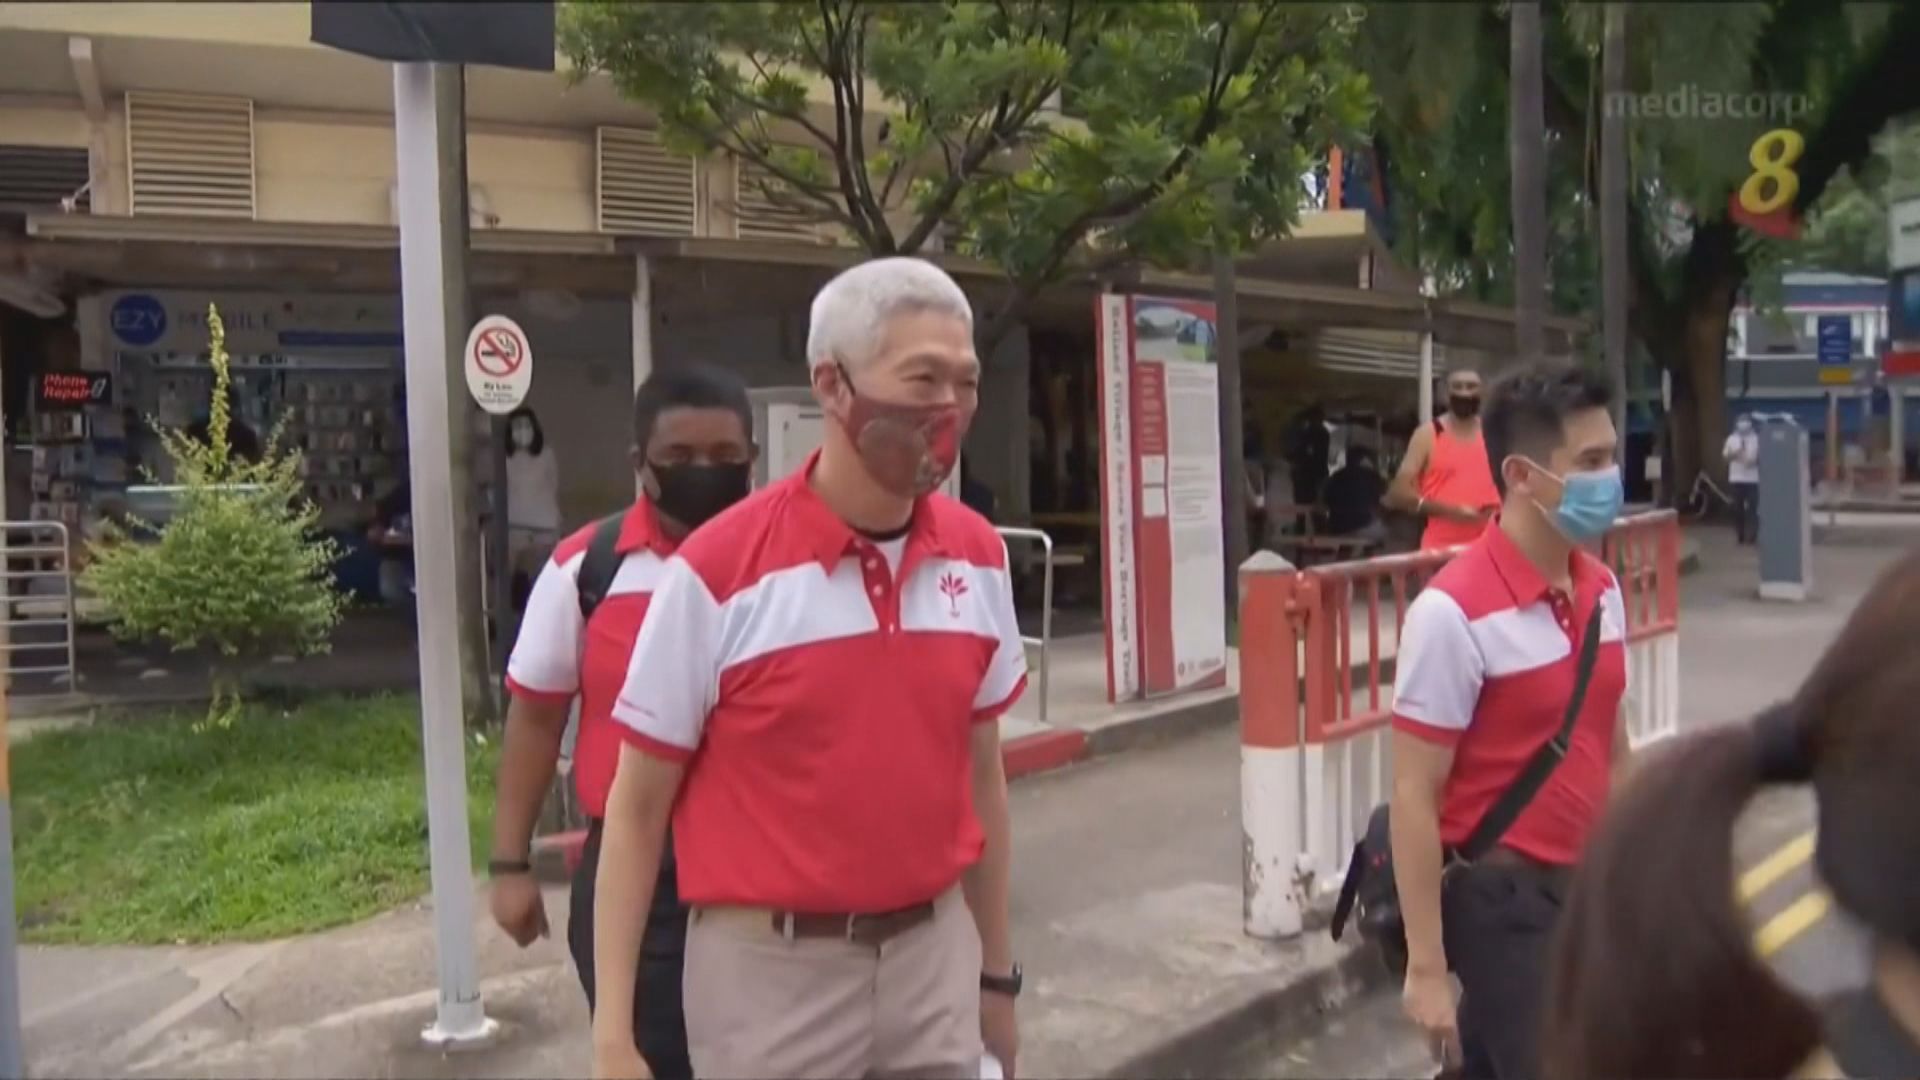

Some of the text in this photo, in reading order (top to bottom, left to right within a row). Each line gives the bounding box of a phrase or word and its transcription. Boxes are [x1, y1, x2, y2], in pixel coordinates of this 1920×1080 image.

[113, 309, 163, 330] EZY
[44, 373, 88, 387] Phone
[44, 386, 90, 400] Repair
